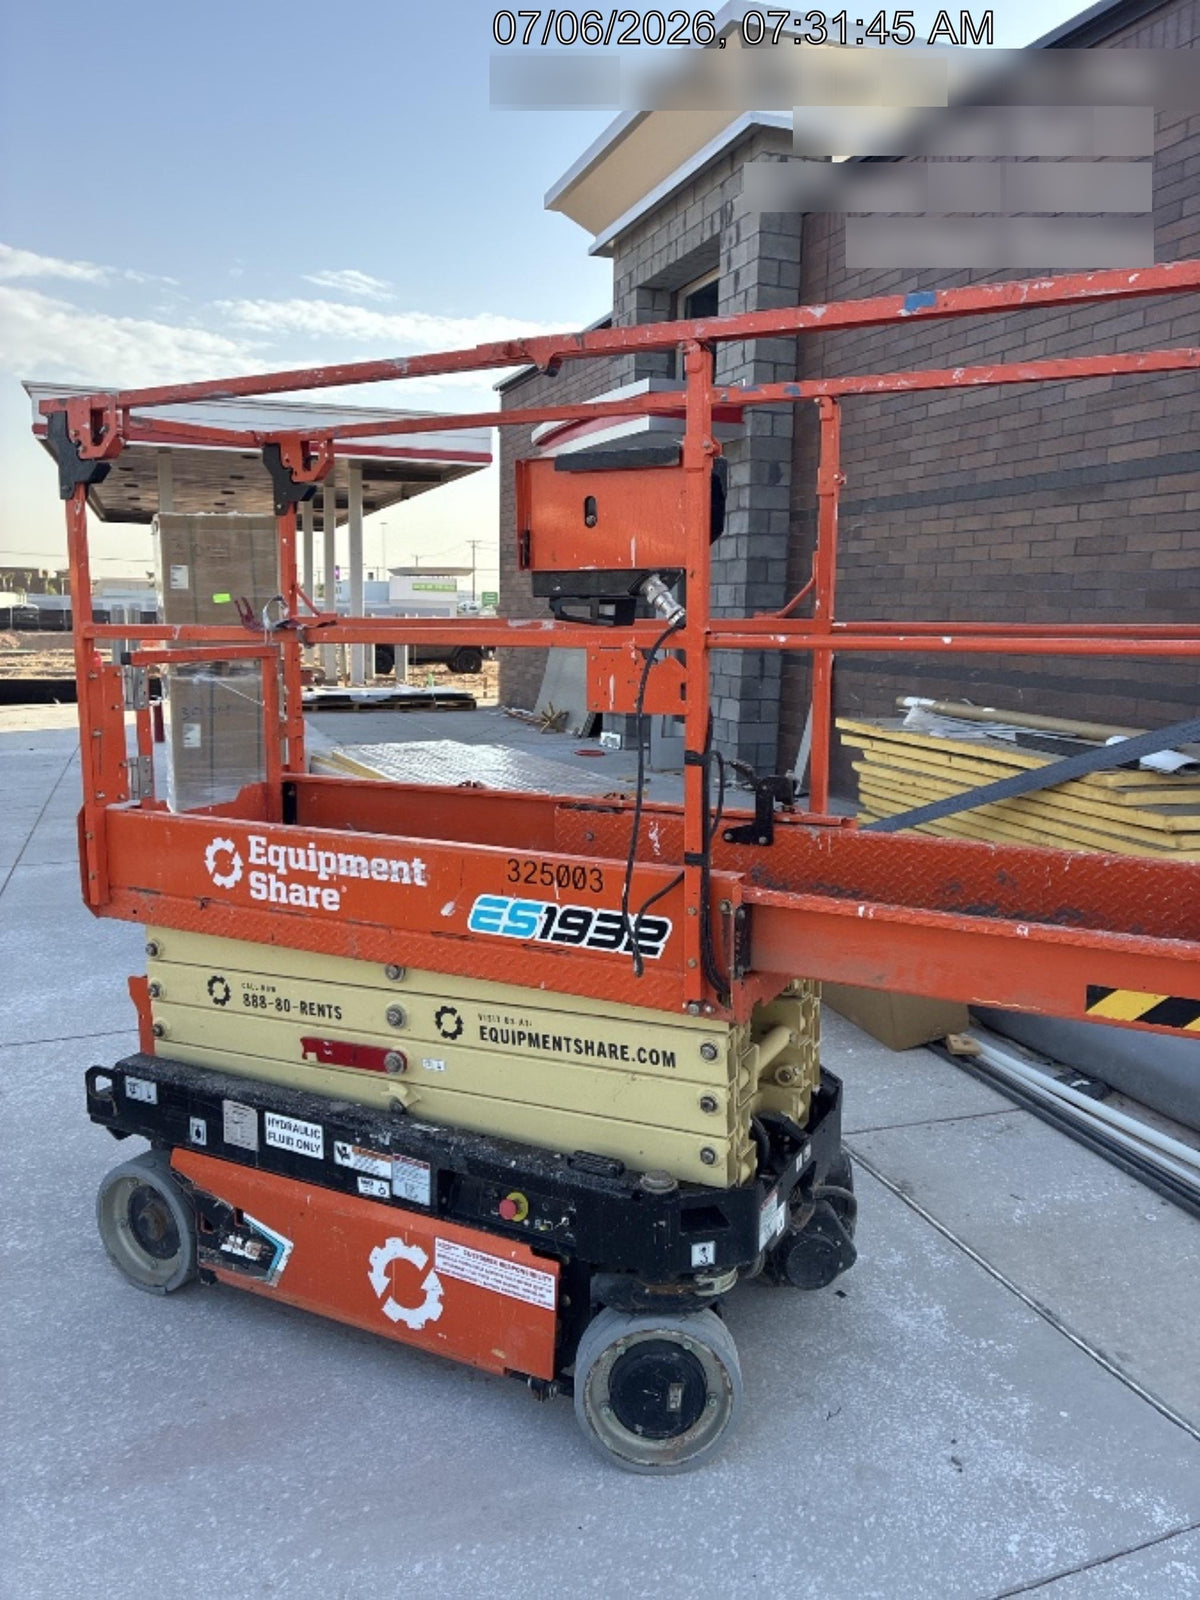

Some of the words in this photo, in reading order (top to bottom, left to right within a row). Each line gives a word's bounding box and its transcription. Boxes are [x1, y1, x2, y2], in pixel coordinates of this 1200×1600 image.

[247, 834, 428, 888] Equipment
[507, 858, 604, 893] 325003
[249, 872, 341, 911] Share
[469, 894, 671, 958] ES1932
[242, 993, 342, 1020] 888-80-RENTS
[479, 1025, 677, 1068] EQUIPMENTSHARE.COM
[267, 1116, 321, 1140] HYDRAULIC
[267, 1130, 294, 1146] FLUID
[296, 1138, 321, 1154] ONLY
